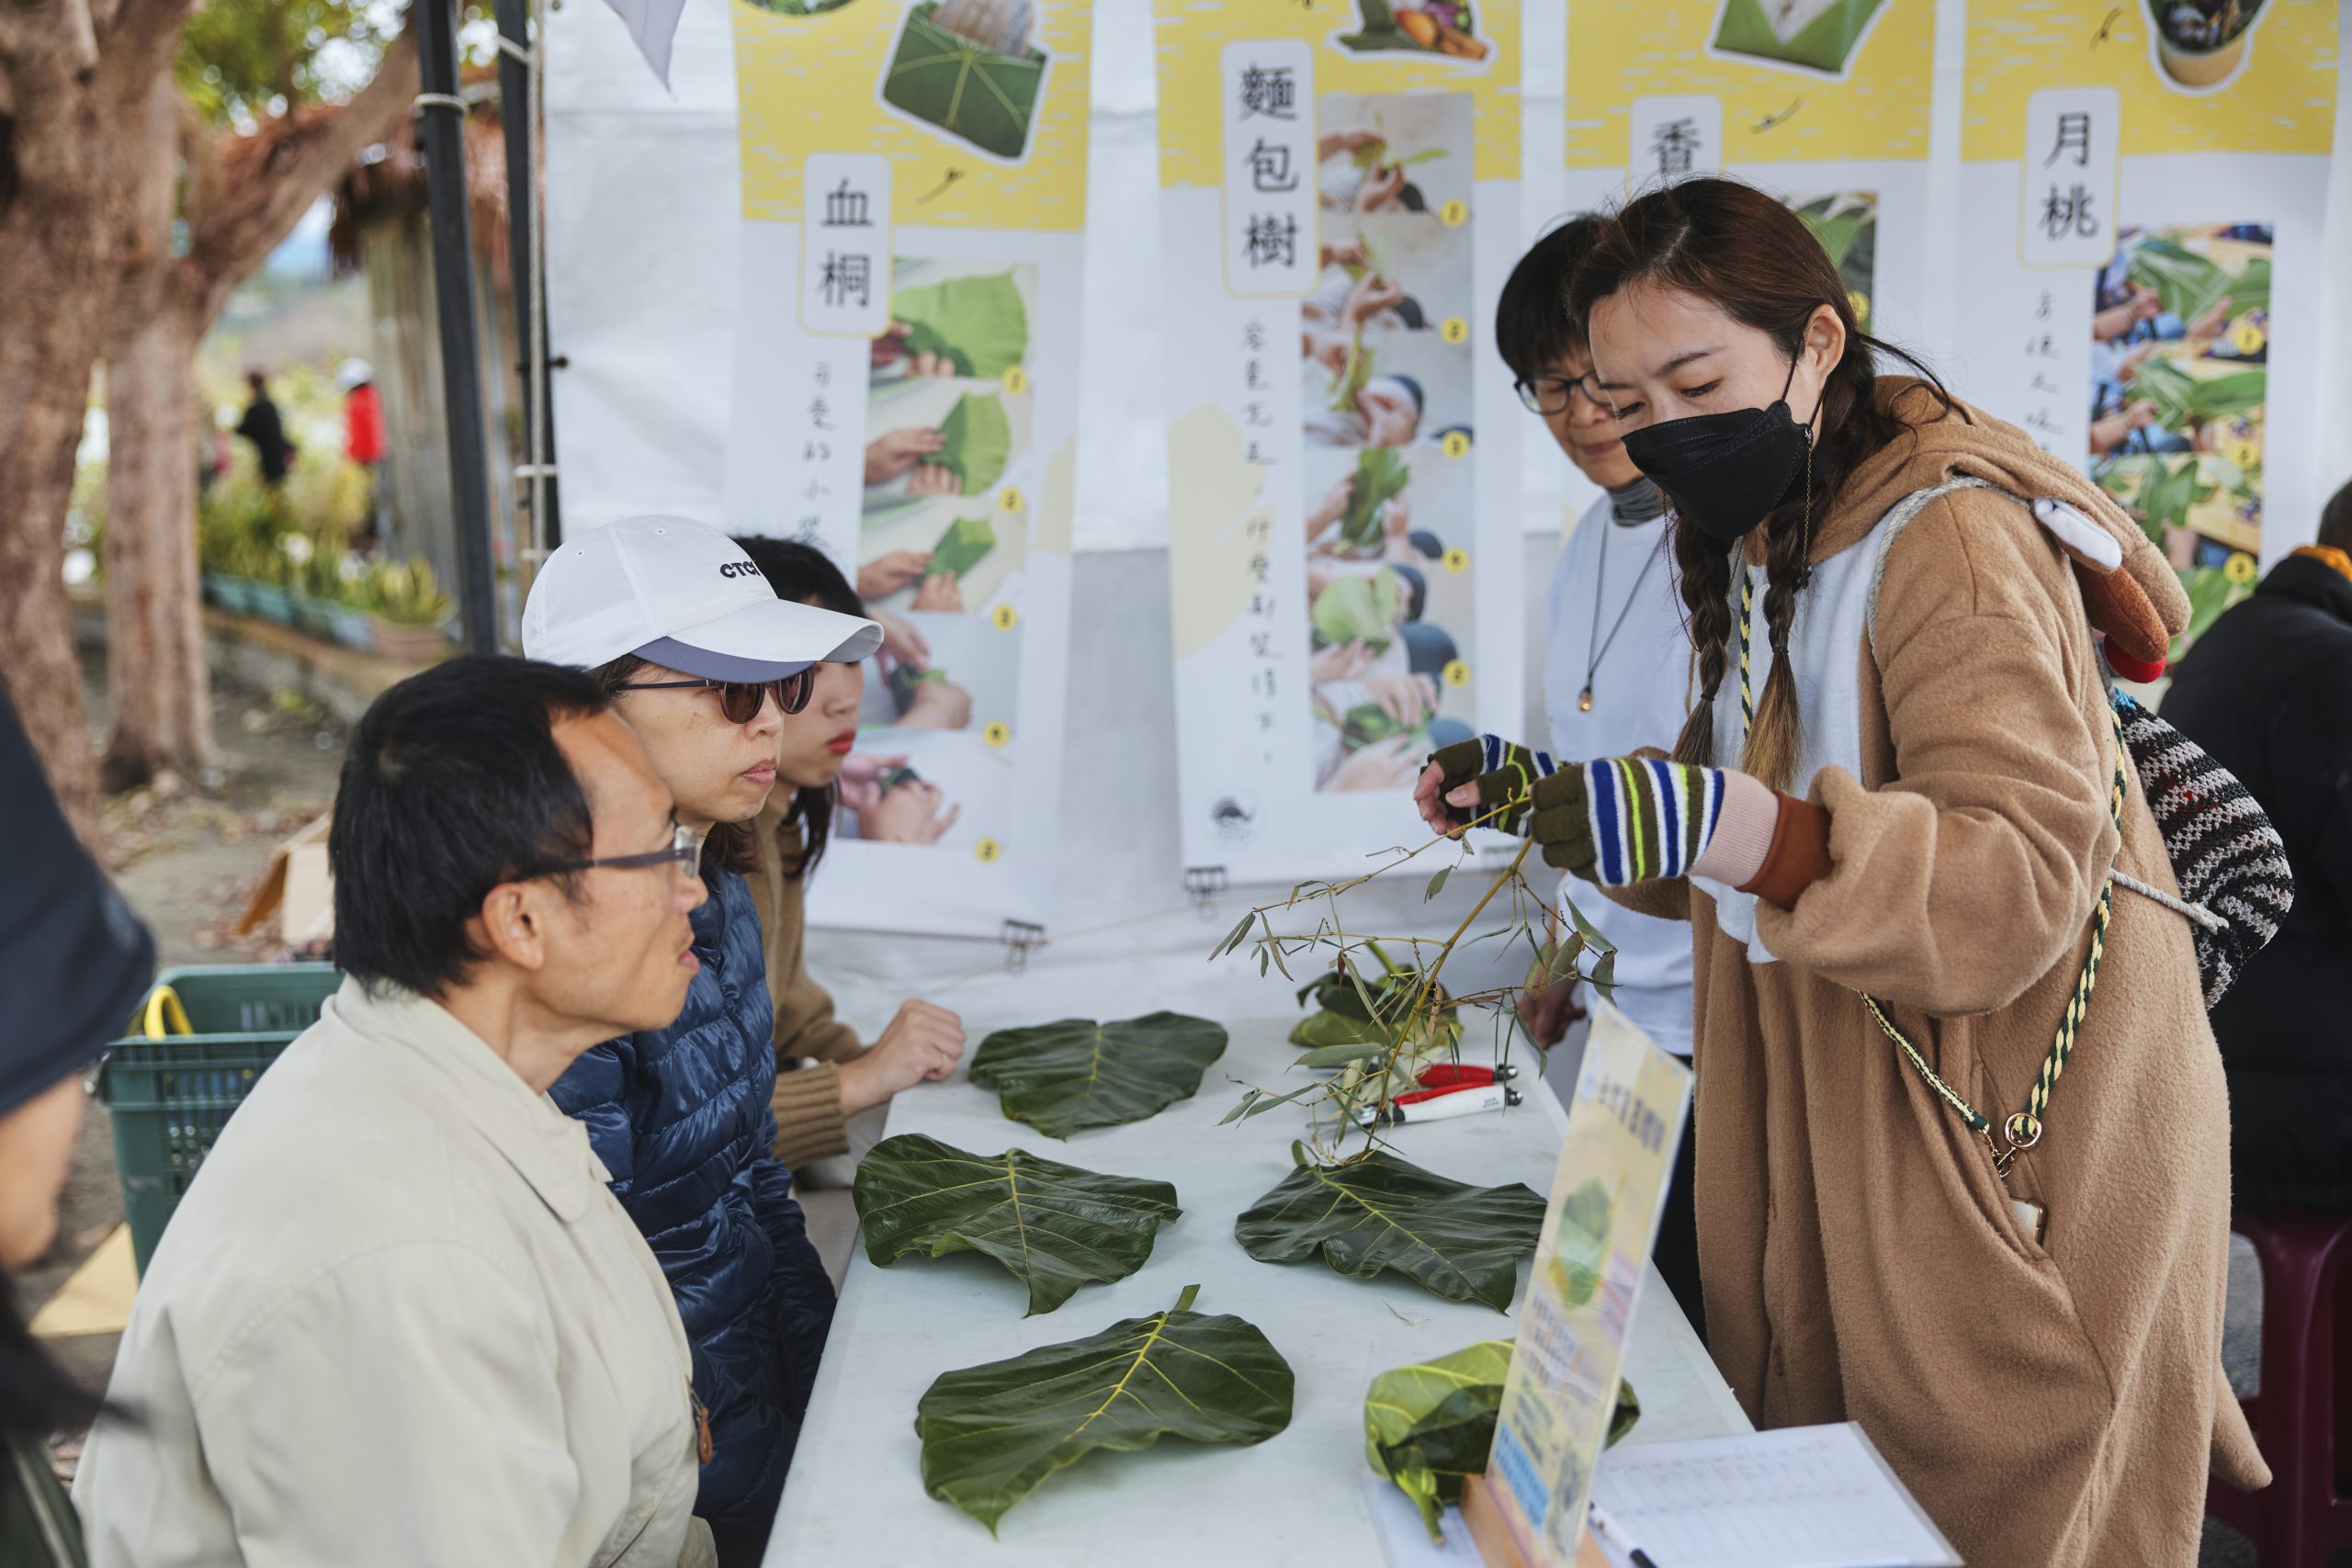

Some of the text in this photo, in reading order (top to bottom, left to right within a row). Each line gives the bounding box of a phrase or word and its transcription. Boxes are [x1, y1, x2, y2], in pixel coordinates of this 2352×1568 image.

[1238, 62, 1300, 268] 麵包樹
[1650, 117, 1703, 175] 香
[2040, 111, 2098, 241] 月桃
[818, 179, 874, 309] 血桐
